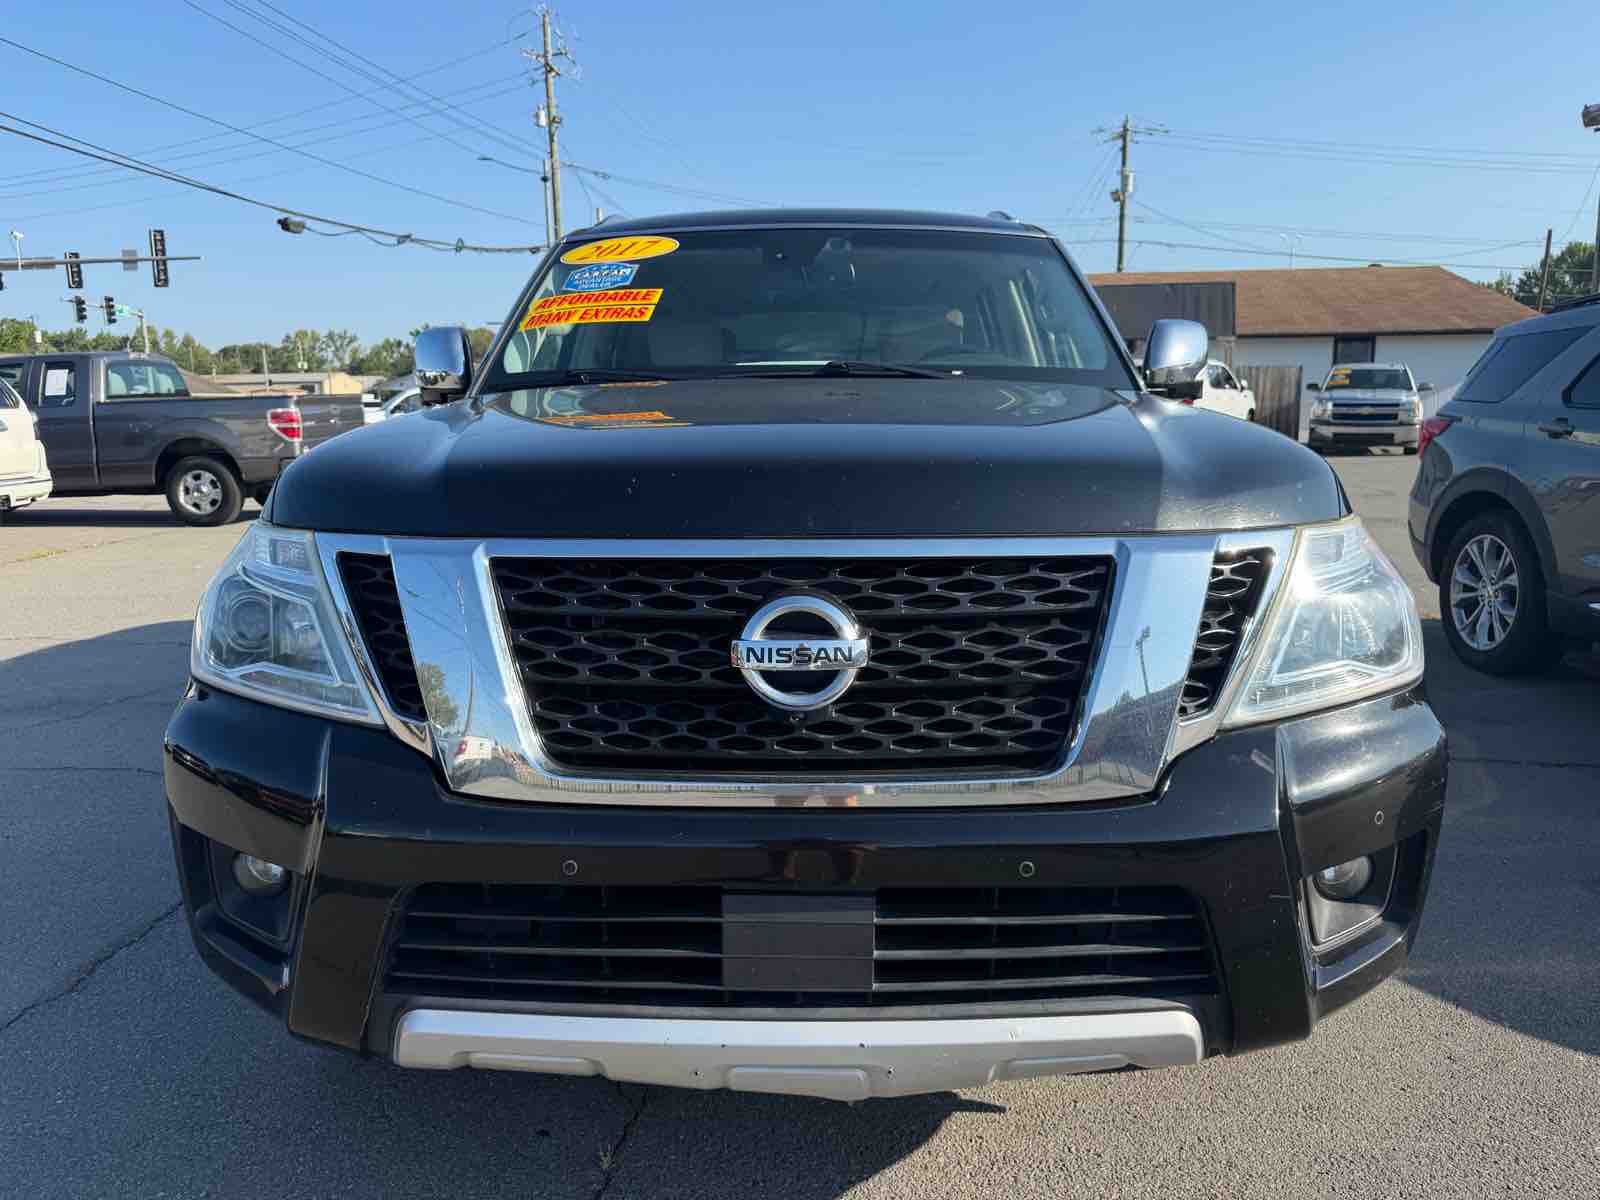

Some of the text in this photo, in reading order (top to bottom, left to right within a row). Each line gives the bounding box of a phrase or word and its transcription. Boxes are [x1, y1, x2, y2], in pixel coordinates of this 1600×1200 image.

[575, 239, 662, 260] 2017
[535, 290, 655, 310] AFFORDABLE
[525, 306, 648, 330] MANY EXTRAS
[746, 646, 853, 664] NISSAN
